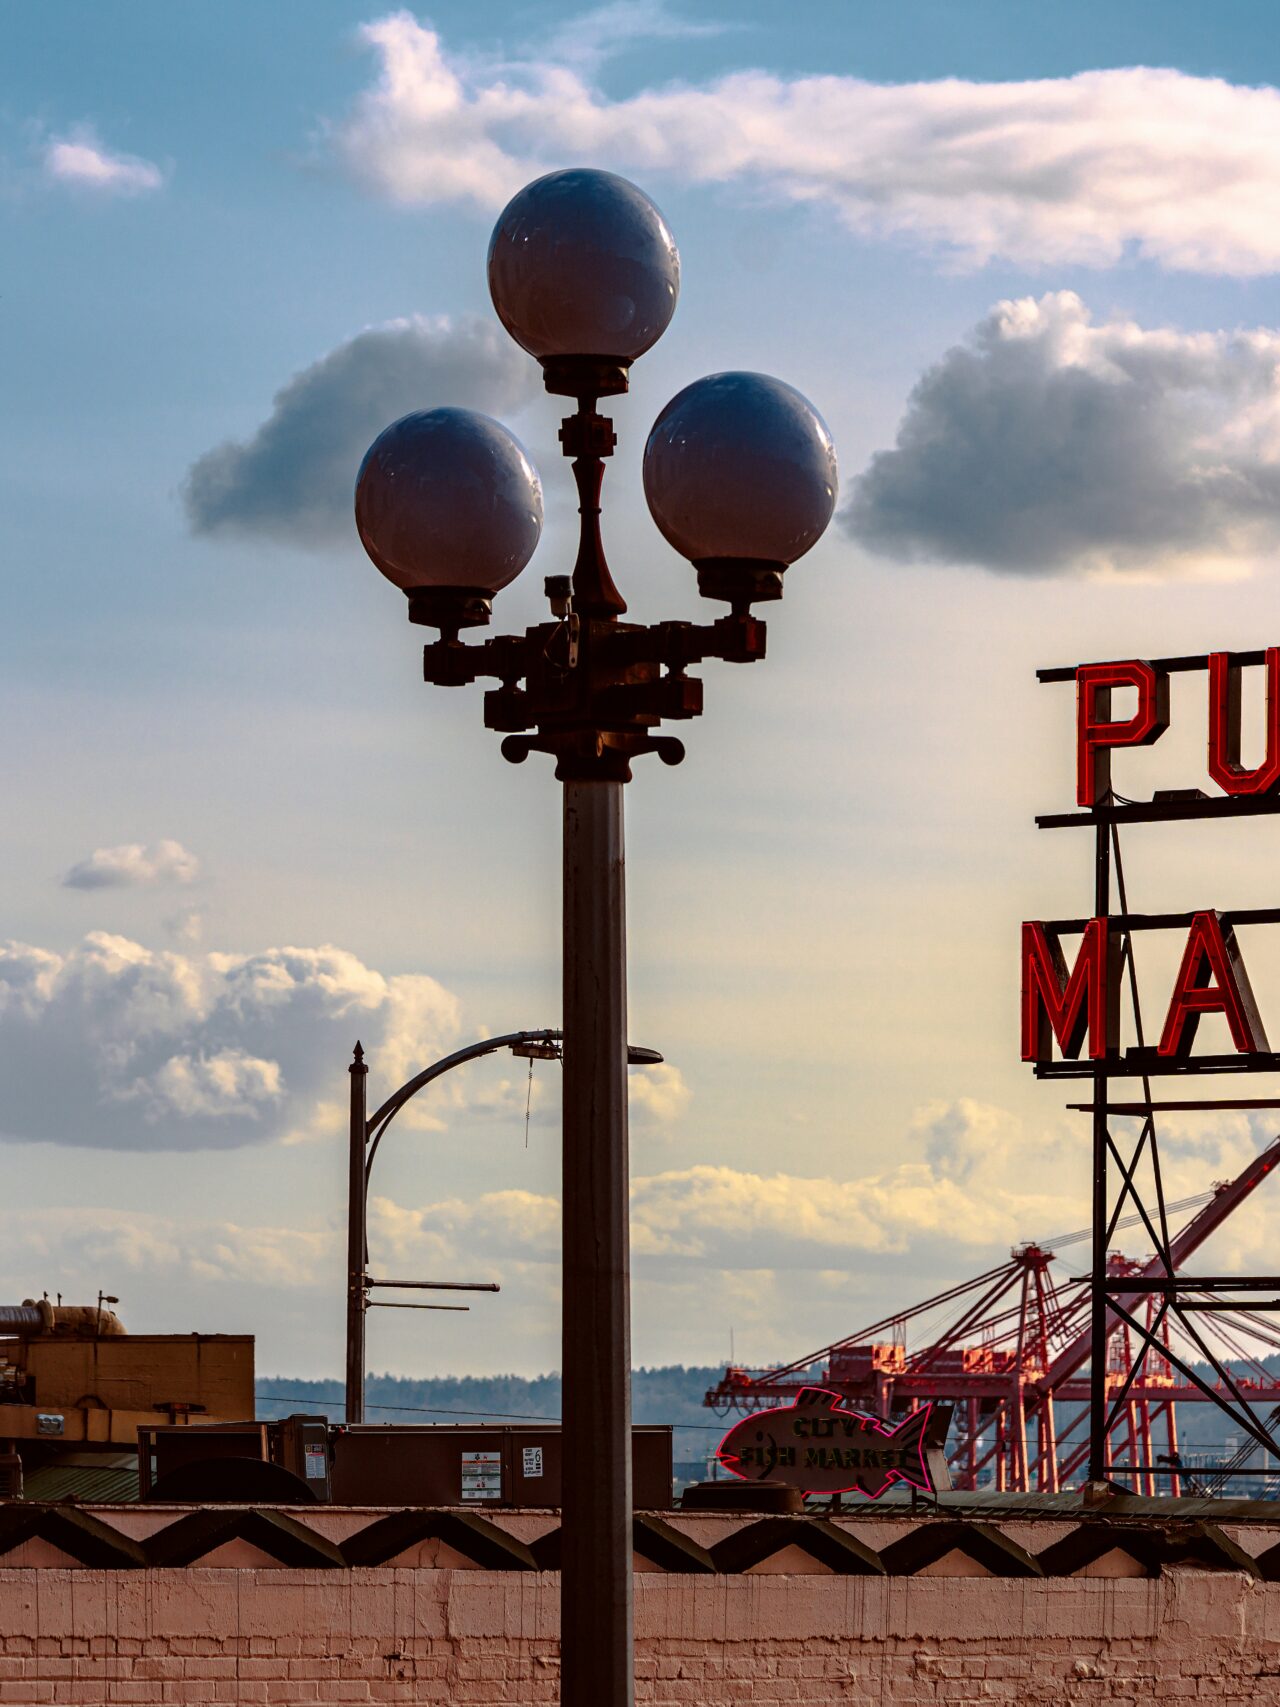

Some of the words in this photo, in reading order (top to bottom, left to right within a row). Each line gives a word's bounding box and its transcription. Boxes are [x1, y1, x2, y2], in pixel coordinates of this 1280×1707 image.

[792, 1417, 859, 1438] CITY
[739, 1446, 796, 1466] FISH
[804, 1447, 909, 1469] MARKET
